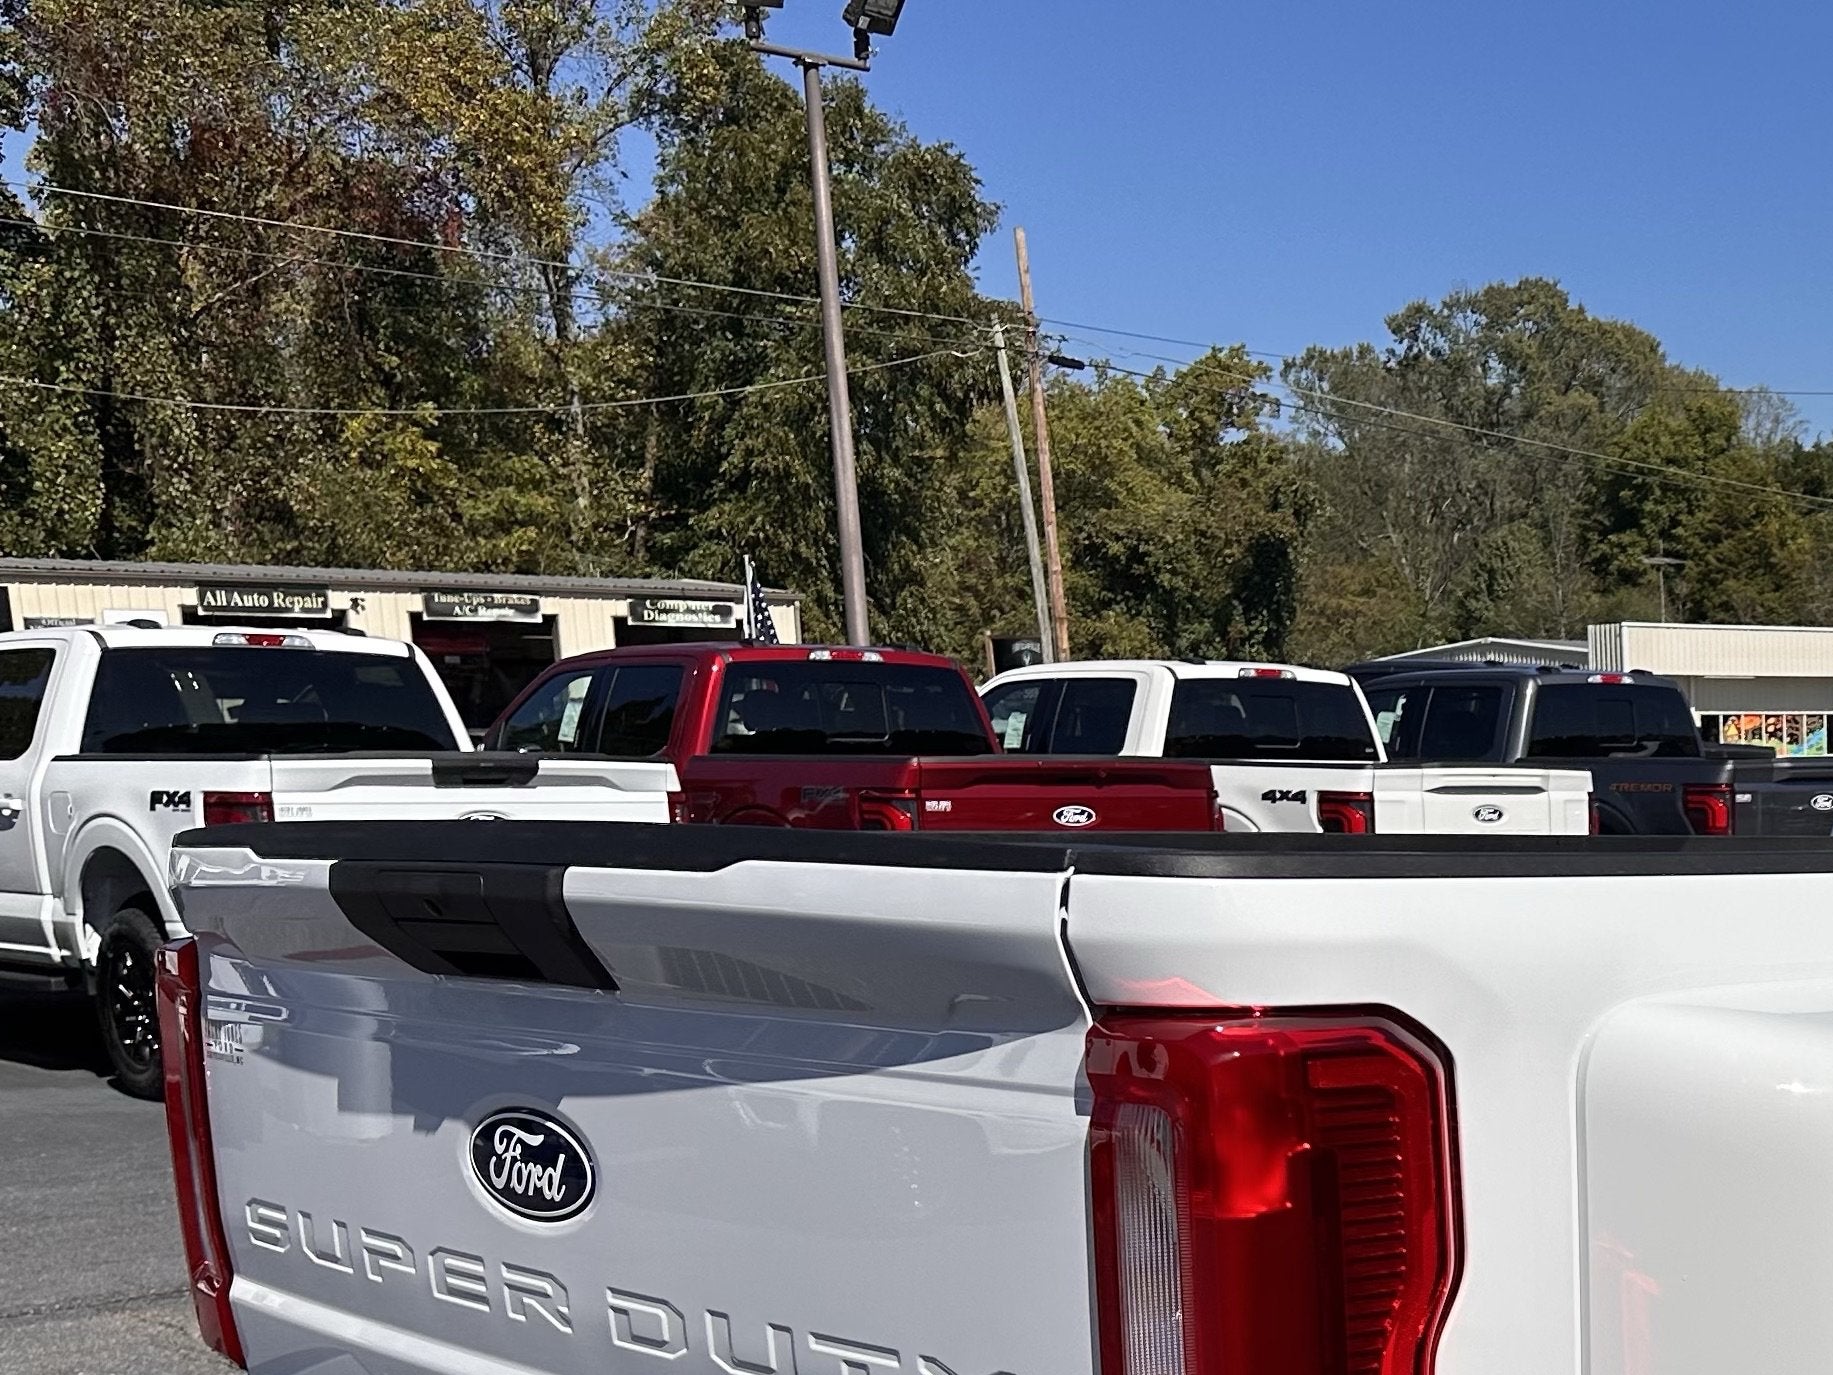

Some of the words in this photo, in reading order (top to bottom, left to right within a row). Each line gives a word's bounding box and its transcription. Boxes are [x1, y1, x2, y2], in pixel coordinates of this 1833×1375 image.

[202, 589, 228, 607] All
[230, 591, 270, 608] Auto
[272, 592, 326, 613] Repair
[150, 791, 191, 812] FX4
[1060, 807, 1089, 823] Ford
[489, 1124, 566, 1202] Ford
[245, 1197, 574, 1336] SUPER
